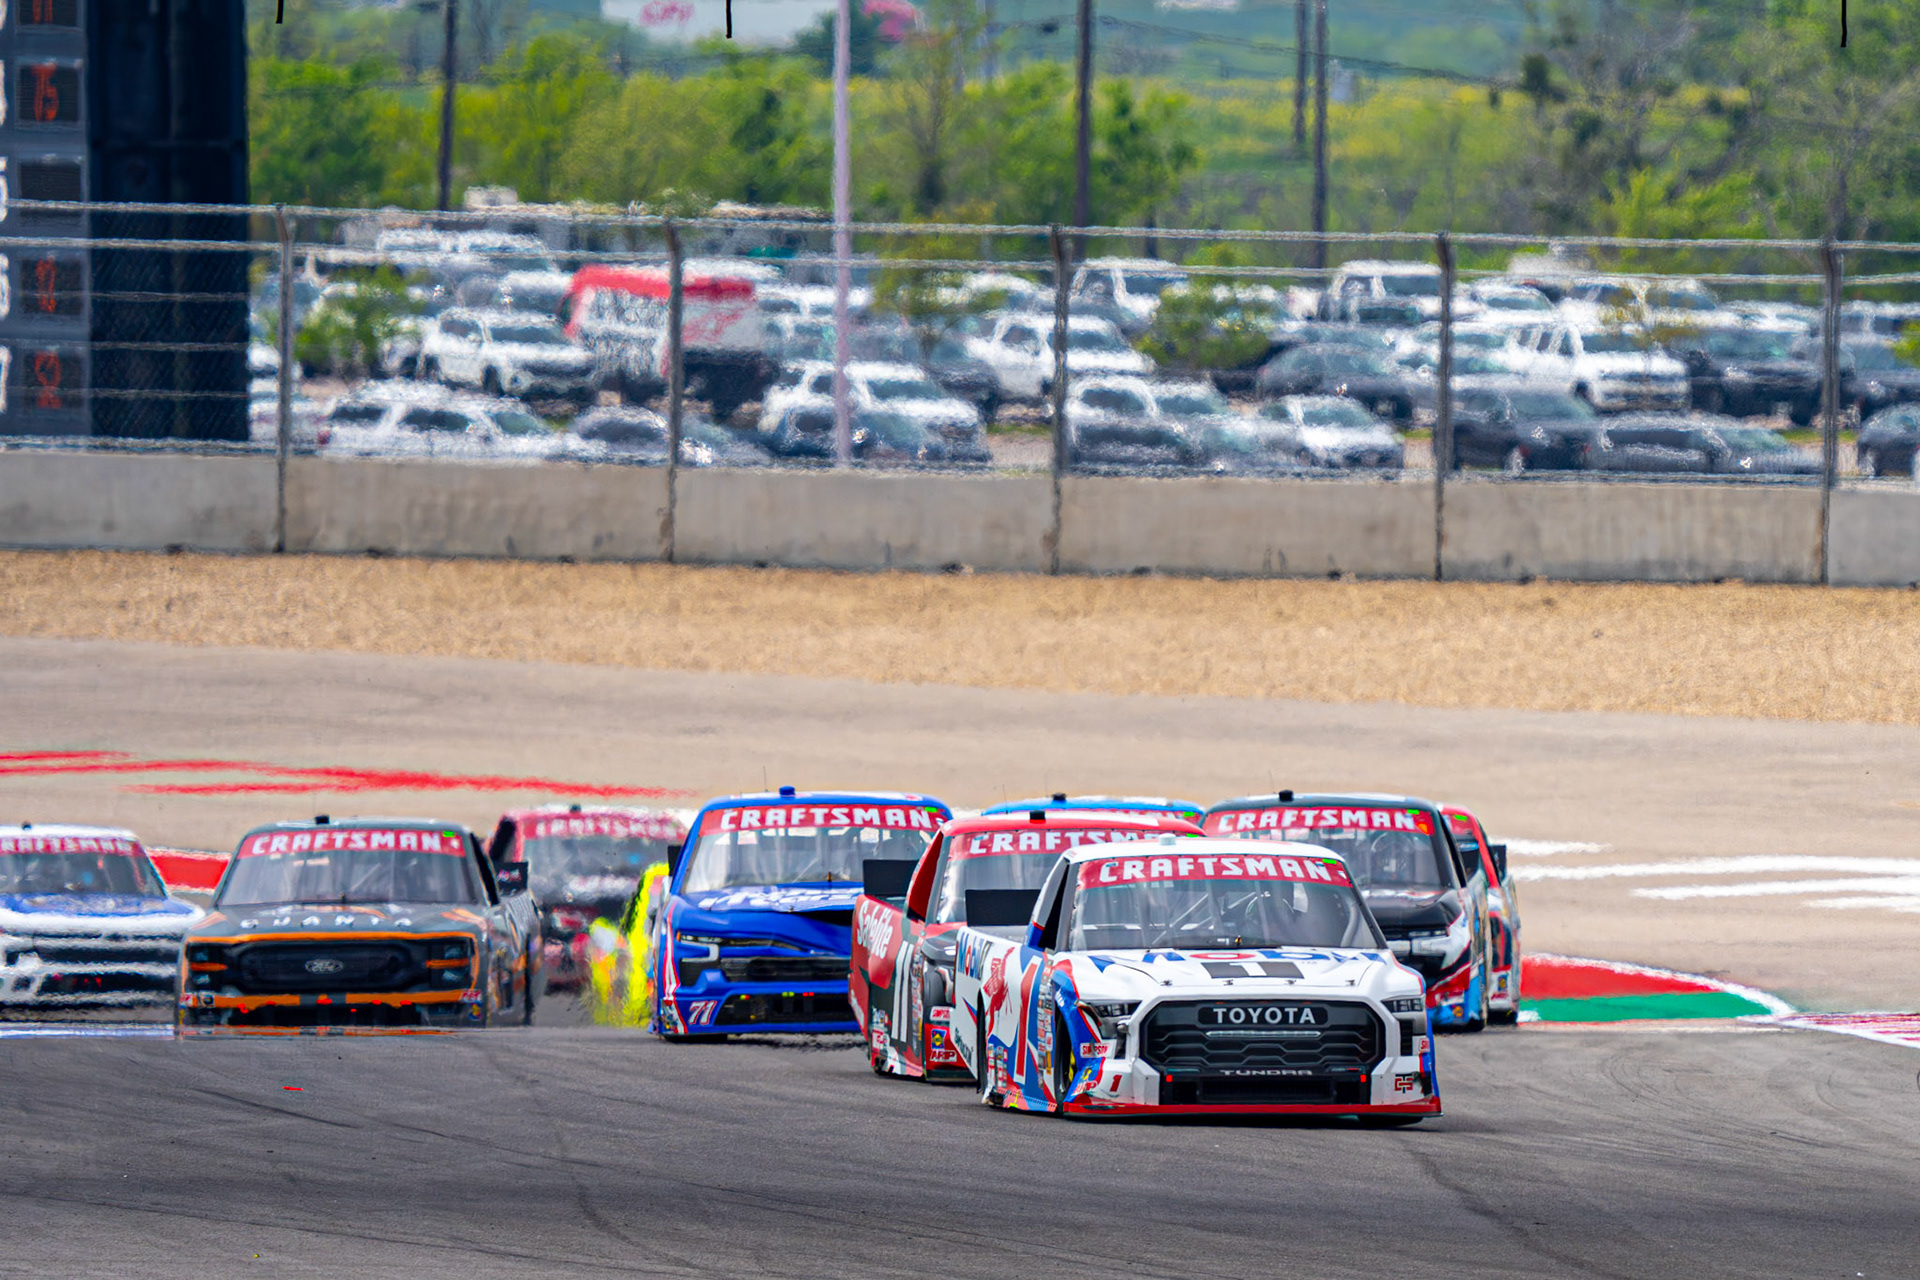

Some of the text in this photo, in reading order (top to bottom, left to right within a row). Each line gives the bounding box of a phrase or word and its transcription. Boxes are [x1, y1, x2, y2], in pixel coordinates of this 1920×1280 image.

[720, 807, 932, 830] CRAFTSMAN
[1217, 809, 1419, 831] CRAFTSMAN
[252, 832, 442, 855] CRAFTSMAN
[1099, 857, 1332, 883] CRAFTSMAN
[689, 1000, 718, 1026] 71
[1213, 1007, 1316, 1024] TOYOTA
[1109, 1074, 1123, 1092] 1
